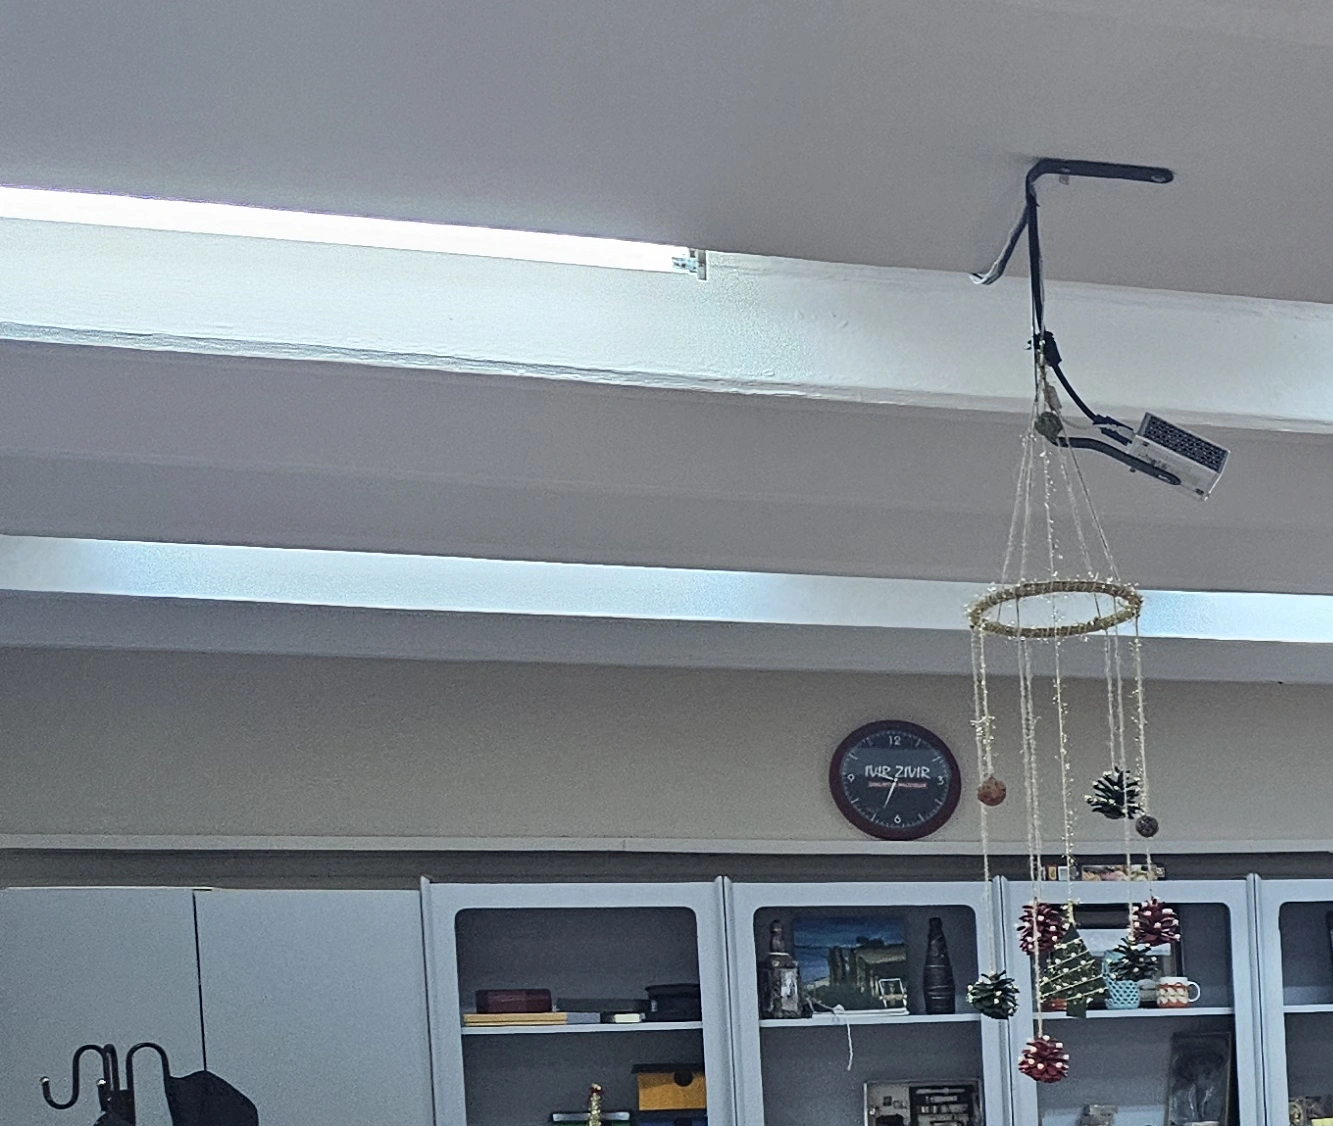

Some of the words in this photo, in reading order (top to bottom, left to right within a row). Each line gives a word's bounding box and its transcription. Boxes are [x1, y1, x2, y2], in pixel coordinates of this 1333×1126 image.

[889, 735, 901, 746] 12
[847, 773, 855, 783] 9
[937, 775, 945, 786] 3
[893, 814, 902, 824] 6
